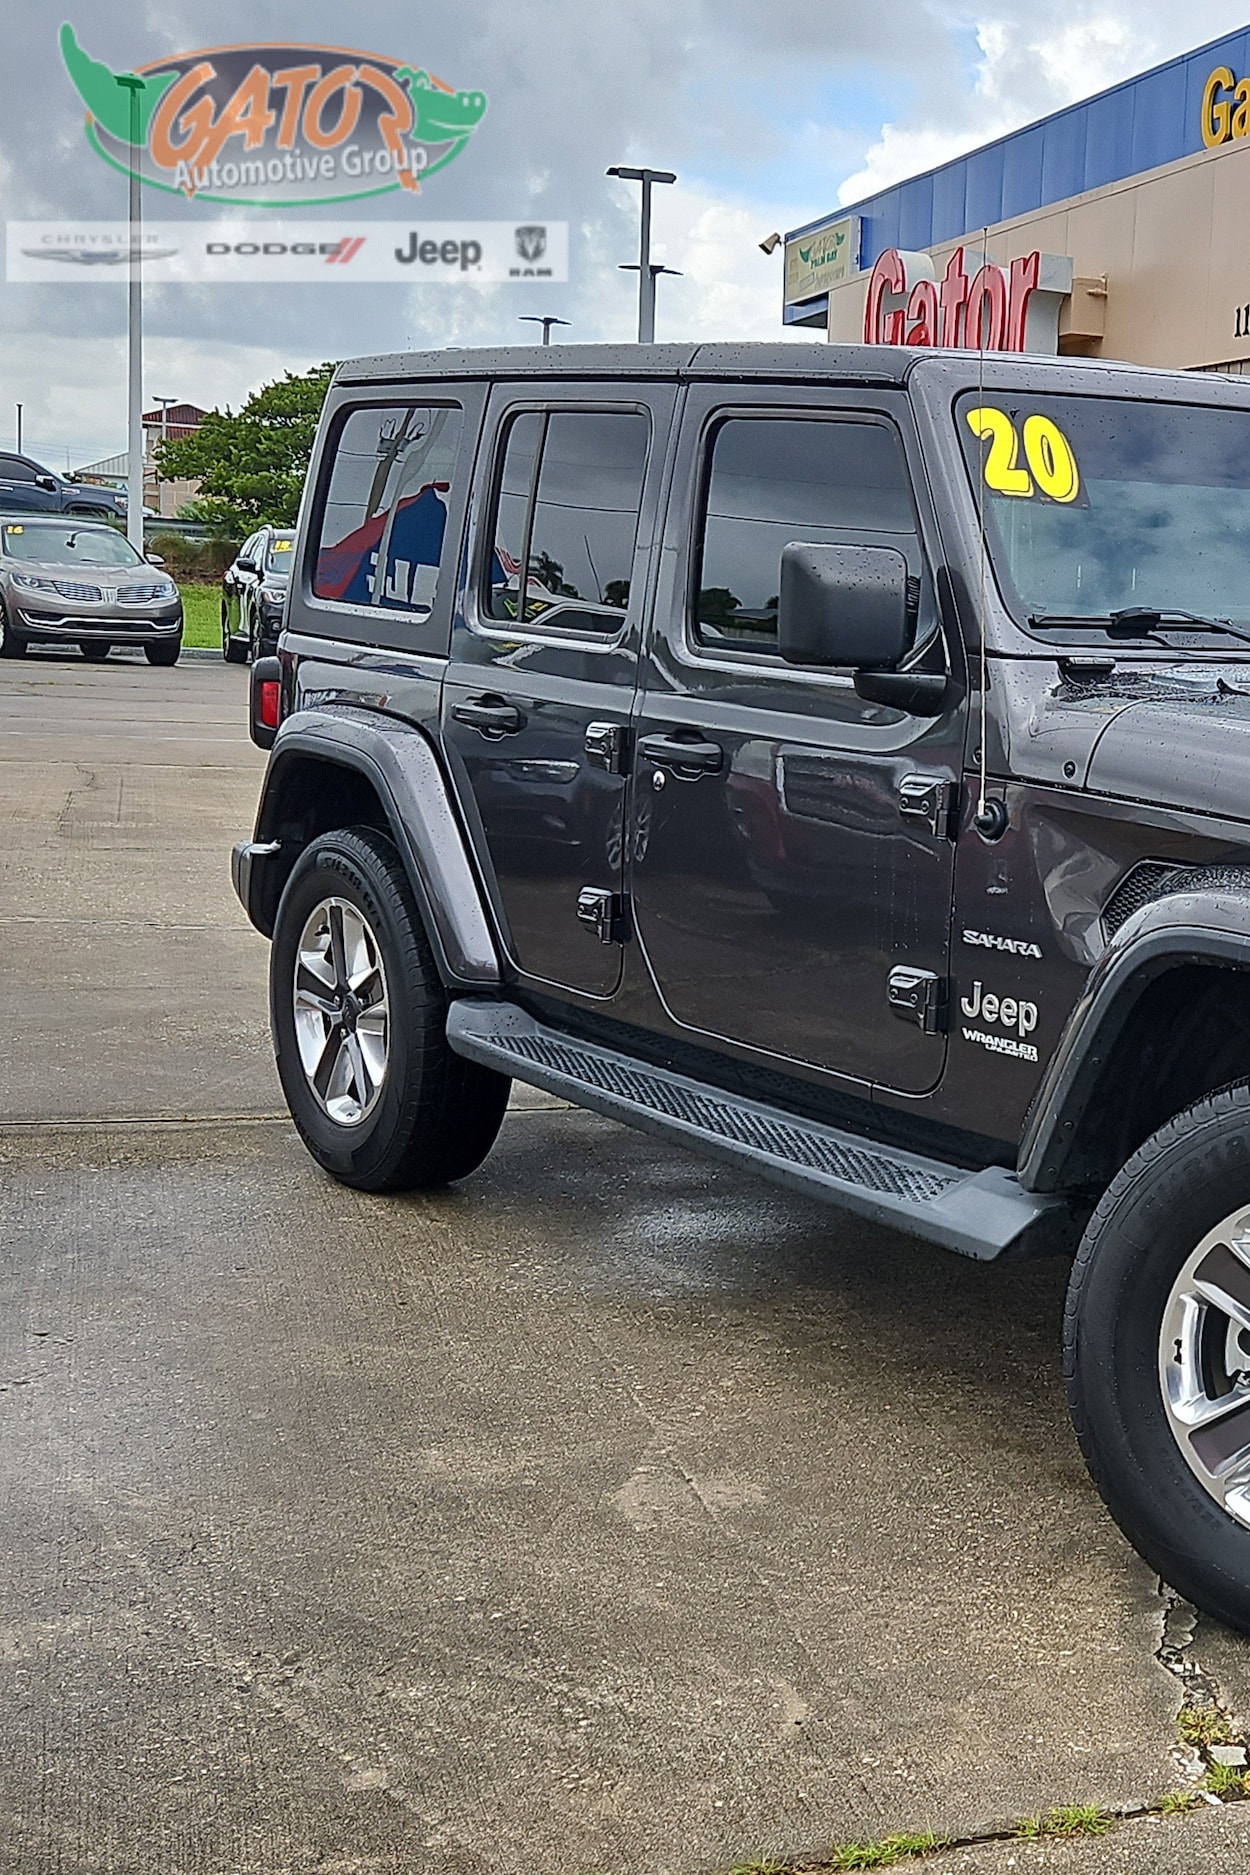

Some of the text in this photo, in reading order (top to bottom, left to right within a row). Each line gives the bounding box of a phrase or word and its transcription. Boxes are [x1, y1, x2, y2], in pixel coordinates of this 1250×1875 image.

[865, 246, 1040, 353] Gator
[965, 407, 1080, 503] 20
[962, 929, 1044, 959] SAHARA
[960, 981, 1039, 1037] Jeep
[962, 1027, 1039, 1056] WRANGLER
